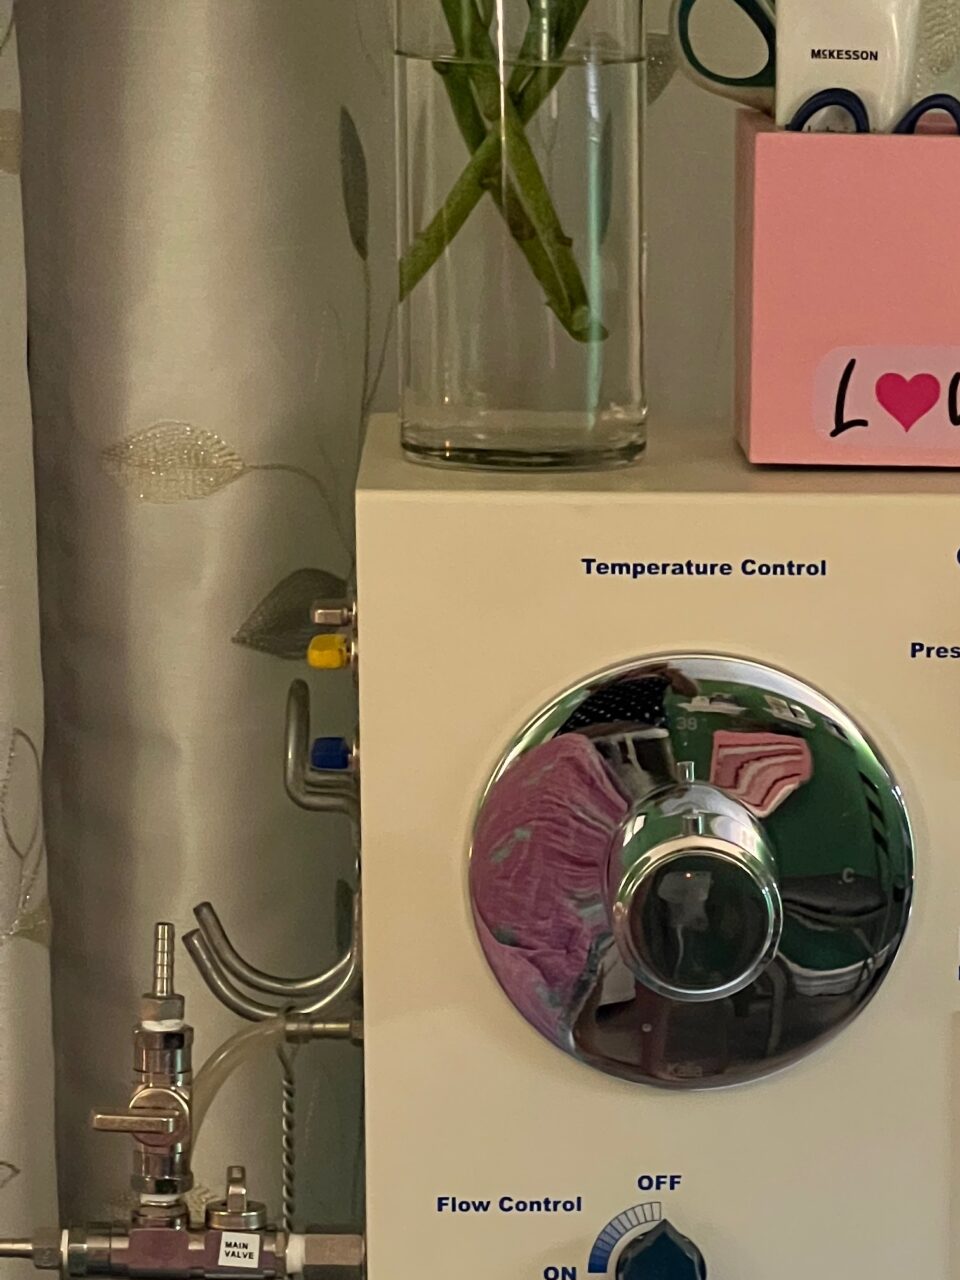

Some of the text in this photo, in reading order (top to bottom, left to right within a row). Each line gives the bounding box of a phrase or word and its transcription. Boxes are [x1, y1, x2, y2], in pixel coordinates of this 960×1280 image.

[581, 558, 827, 579] Temperature Control
[637, 1175, 681, 1190] OFF
[437, 1197, 582, 1212] Flow Control
[225, 1251, 254, 1259] VALVE
[543, 1267, 577, 1280] ON
